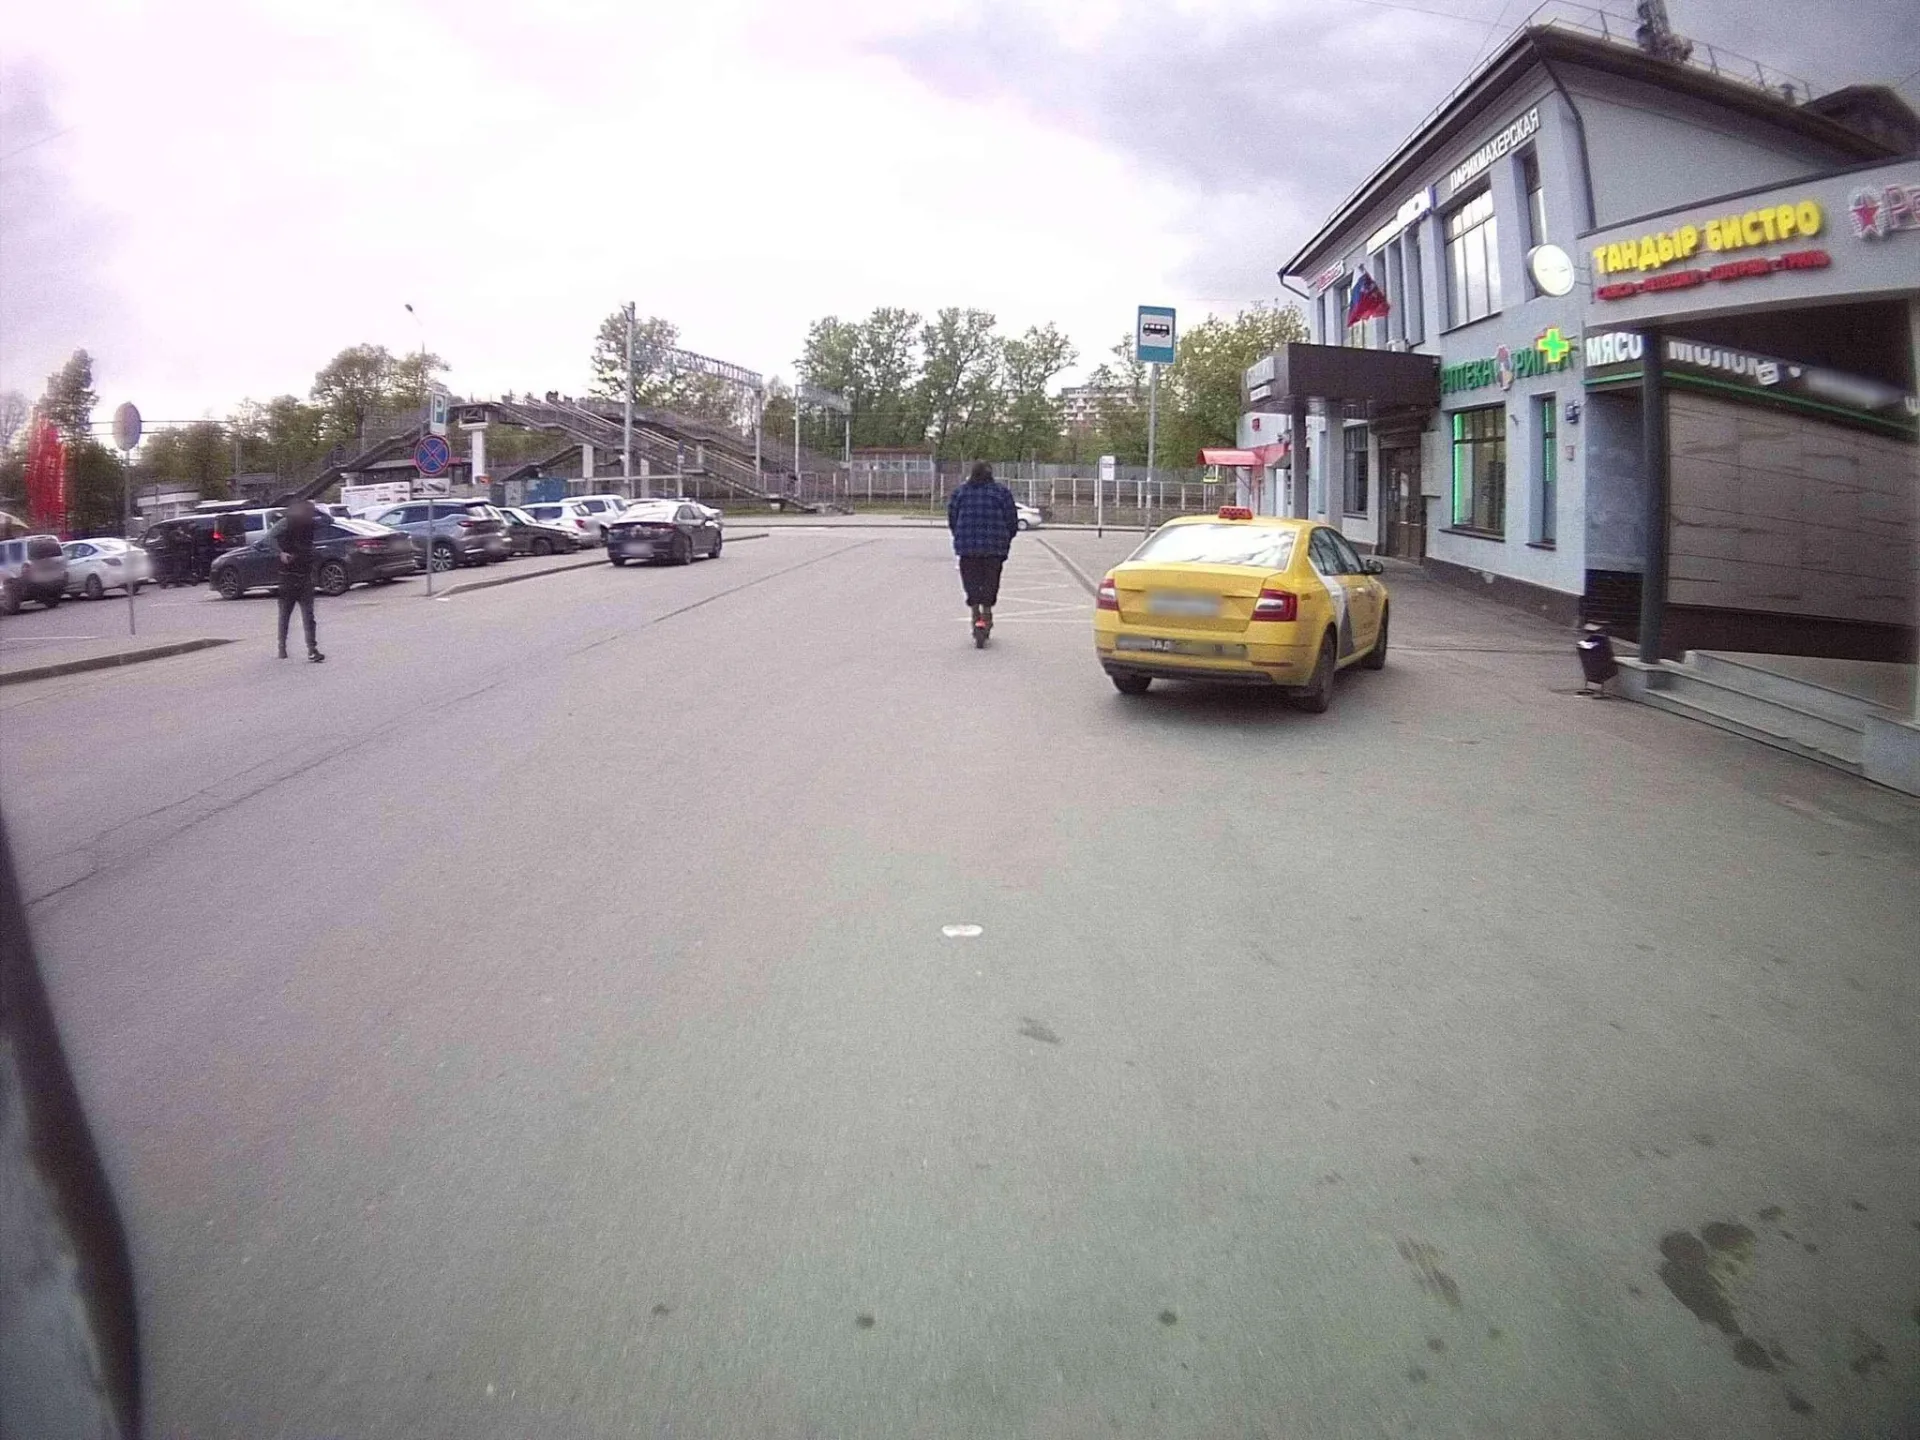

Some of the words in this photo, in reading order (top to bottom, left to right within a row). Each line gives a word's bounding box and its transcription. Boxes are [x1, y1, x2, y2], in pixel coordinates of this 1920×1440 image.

[1449, 107, 1540, 191] ПАРИКМАХЕРСКАЯ
[1593, 224, 1698, 274] ТАНДЫР
[1704, 201, 1822, 252] БИСТРО
[1586, 332, 1643, 367] МЯСО
[1669, 341, 1765, 377] МОЛОК
[1440, 357, 1495, 394] АПТЕКА
